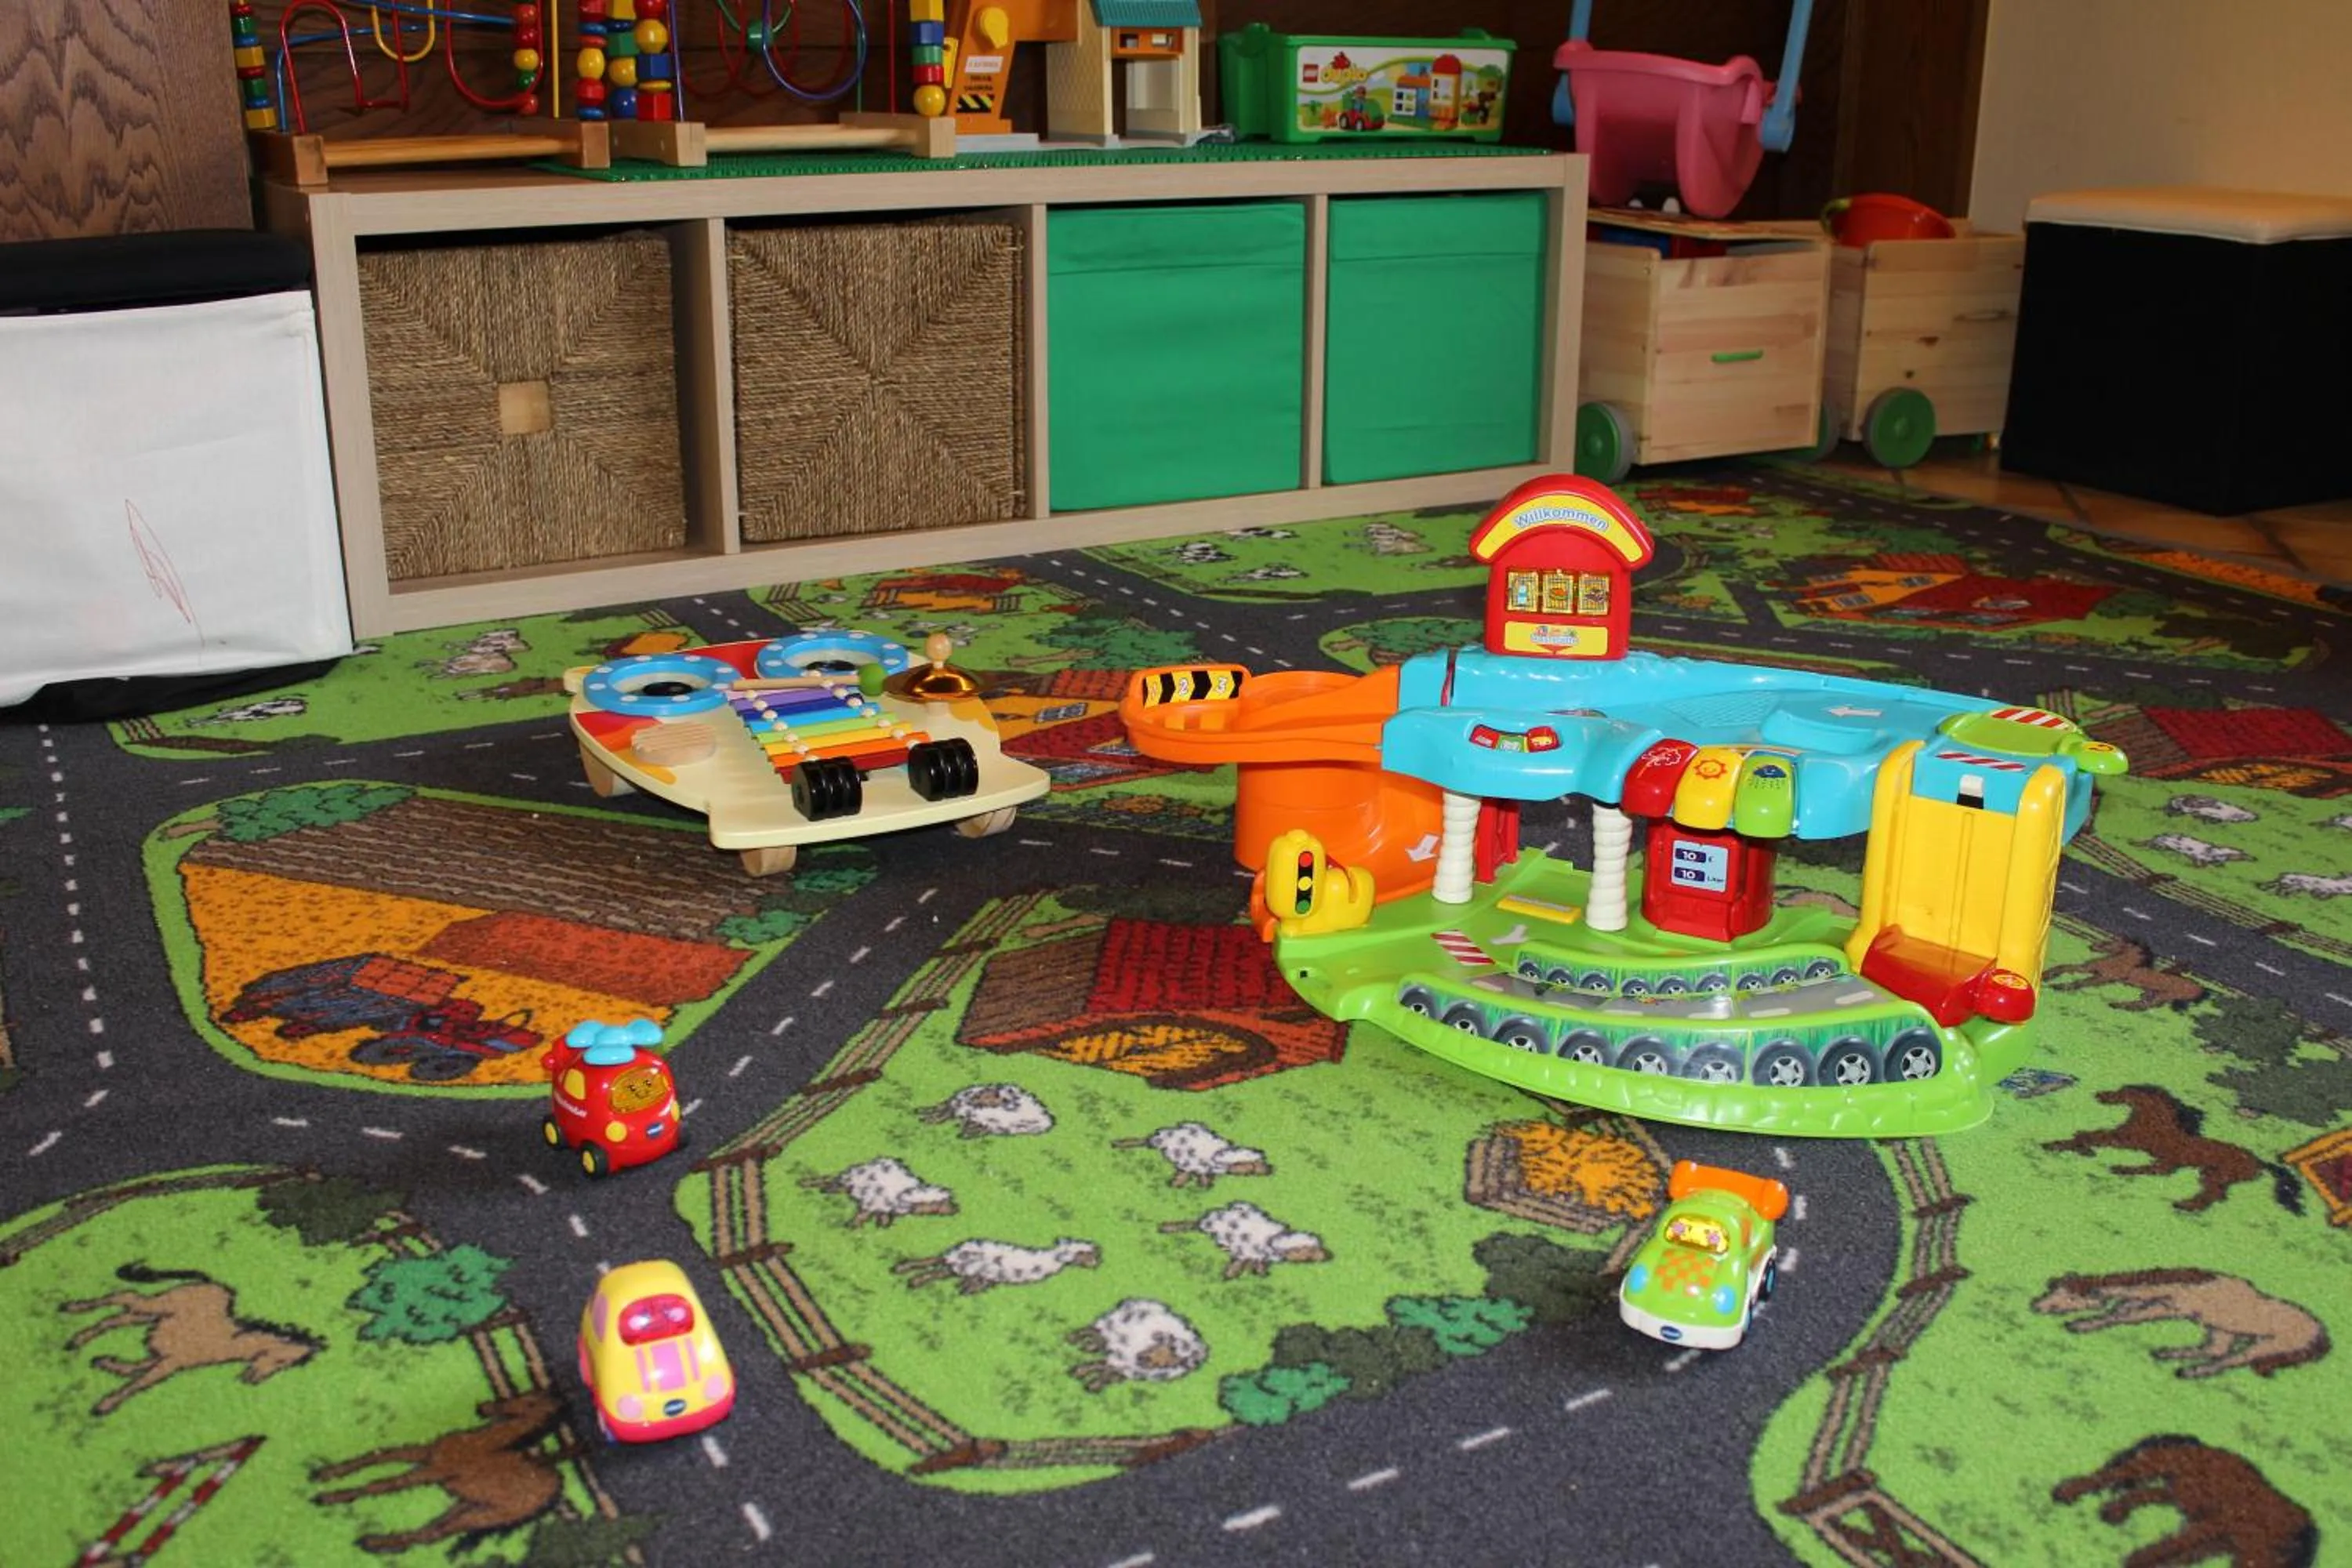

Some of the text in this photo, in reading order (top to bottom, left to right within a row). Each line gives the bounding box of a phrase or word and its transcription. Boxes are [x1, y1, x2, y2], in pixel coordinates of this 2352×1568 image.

[1514, 508, 1609, 530] Willkommen
[1178, 677, 1189, 696] 2
[1216, 677, 1228, 695] 3
[1682, 851, 1697, 861] 10
[1680, 869, 1696, 879] 10
